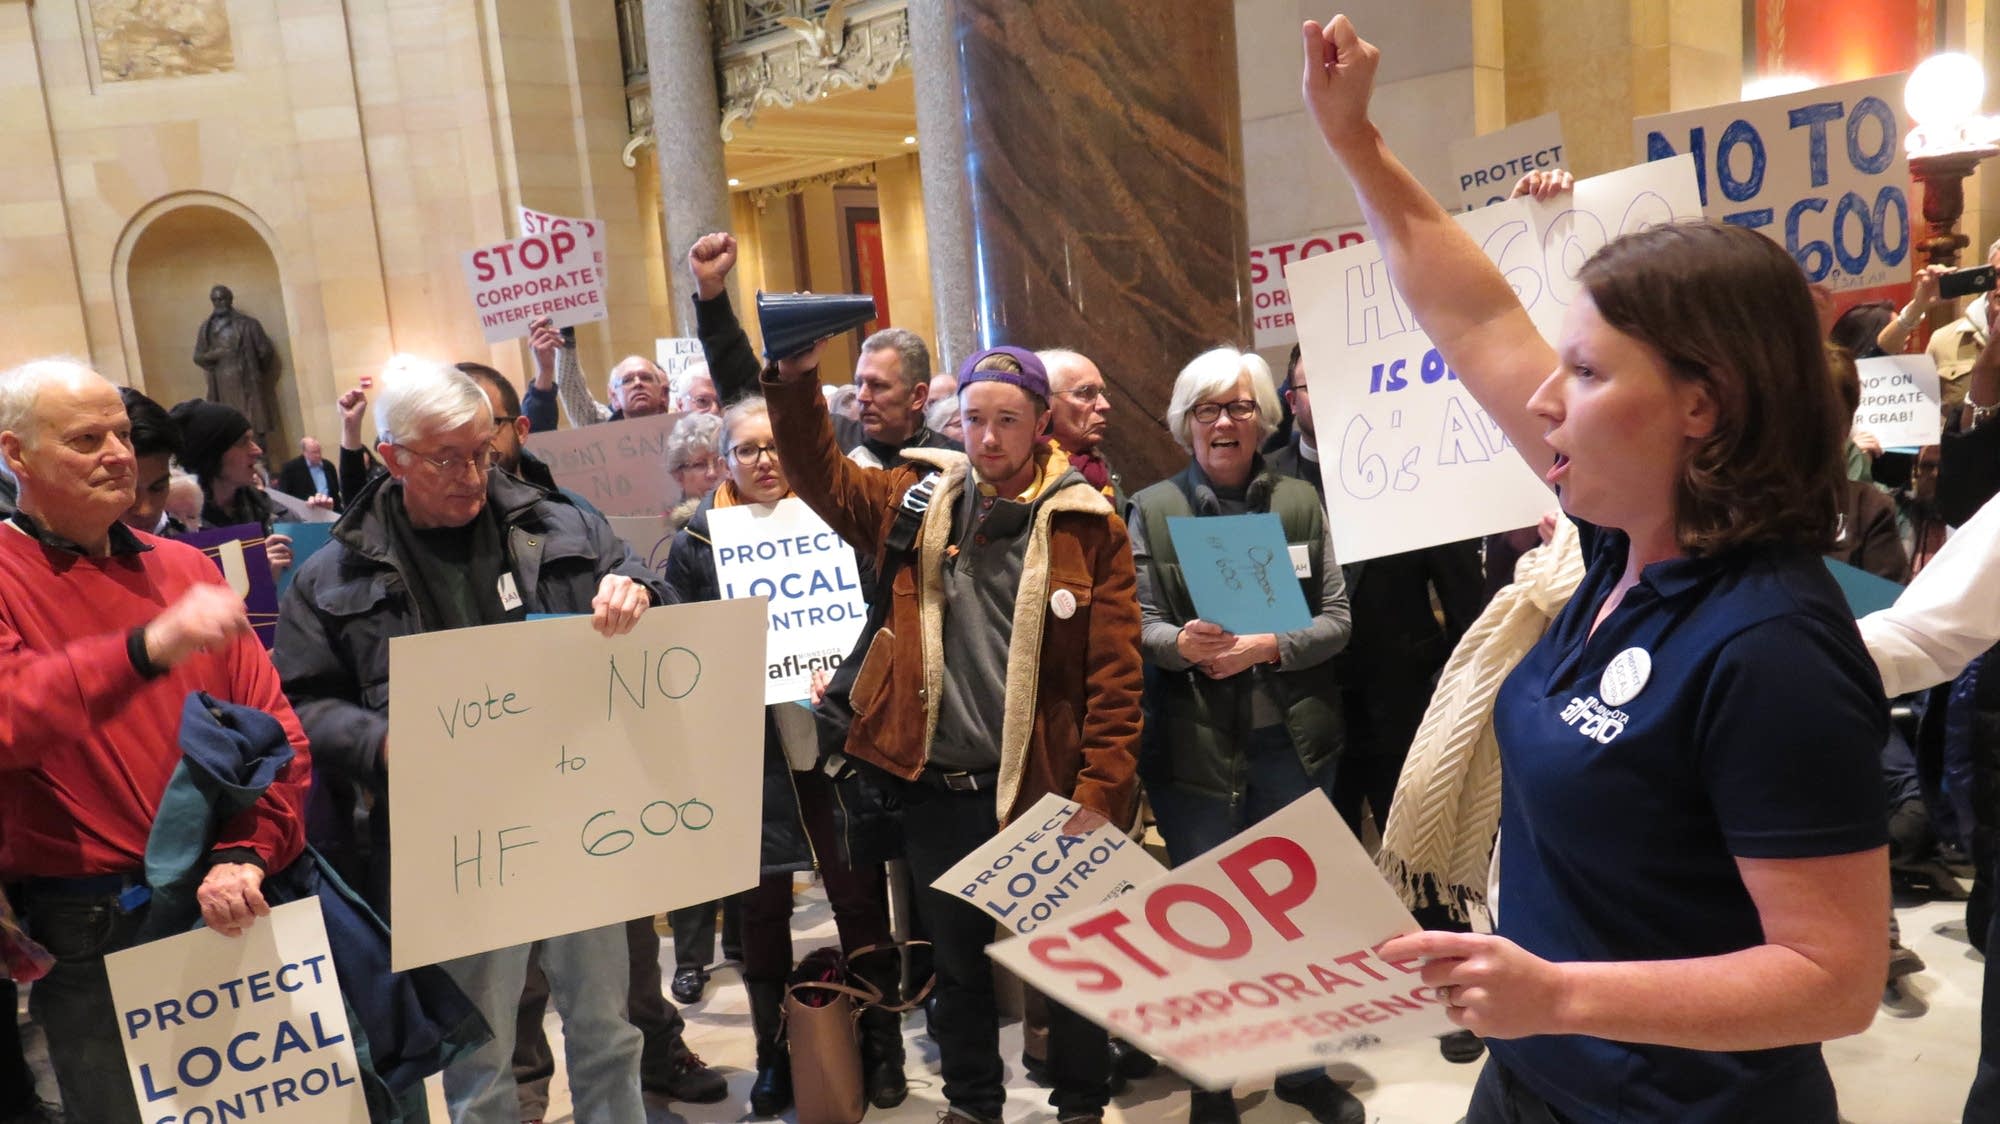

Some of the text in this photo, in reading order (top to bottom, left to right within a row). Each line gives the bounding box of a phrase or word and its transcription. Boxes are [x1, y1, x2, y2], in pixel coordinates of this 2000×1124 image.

[1460, 145, 1562, 191] PROTECT
[1647, 96, 1897, 207] NO TO
[472, 231, 576, 282] STOP
[476, 268, 594, 308] CORPORATE
[482, 290, 599, 327] INTERFERENCE
[1345, 258, 1424, 346] H
[1370, 348, 1458, 394] IS O
[1891, 373, 1913, 387] ON
[1868, 411, 1914, 424] GRAB!
[719, 531, 844, 566] PROTECT
[608, 647, 701, 721] NO
[555, 745, 586, 775] to
[581, 798, 714, 856] 600
[960, 804, 1074, 898] PROTECT
[986, 829, 1096, 918] LOCA
[1016, 837, 1127, 935] CONTROL
[1027, 836, 1318, 995] STOP
[125, 955, 326, 1040] PROTECT
[139, 1012, 345, 1102] LOCAL
[156, 1062, 356, 1124] ONTROL
